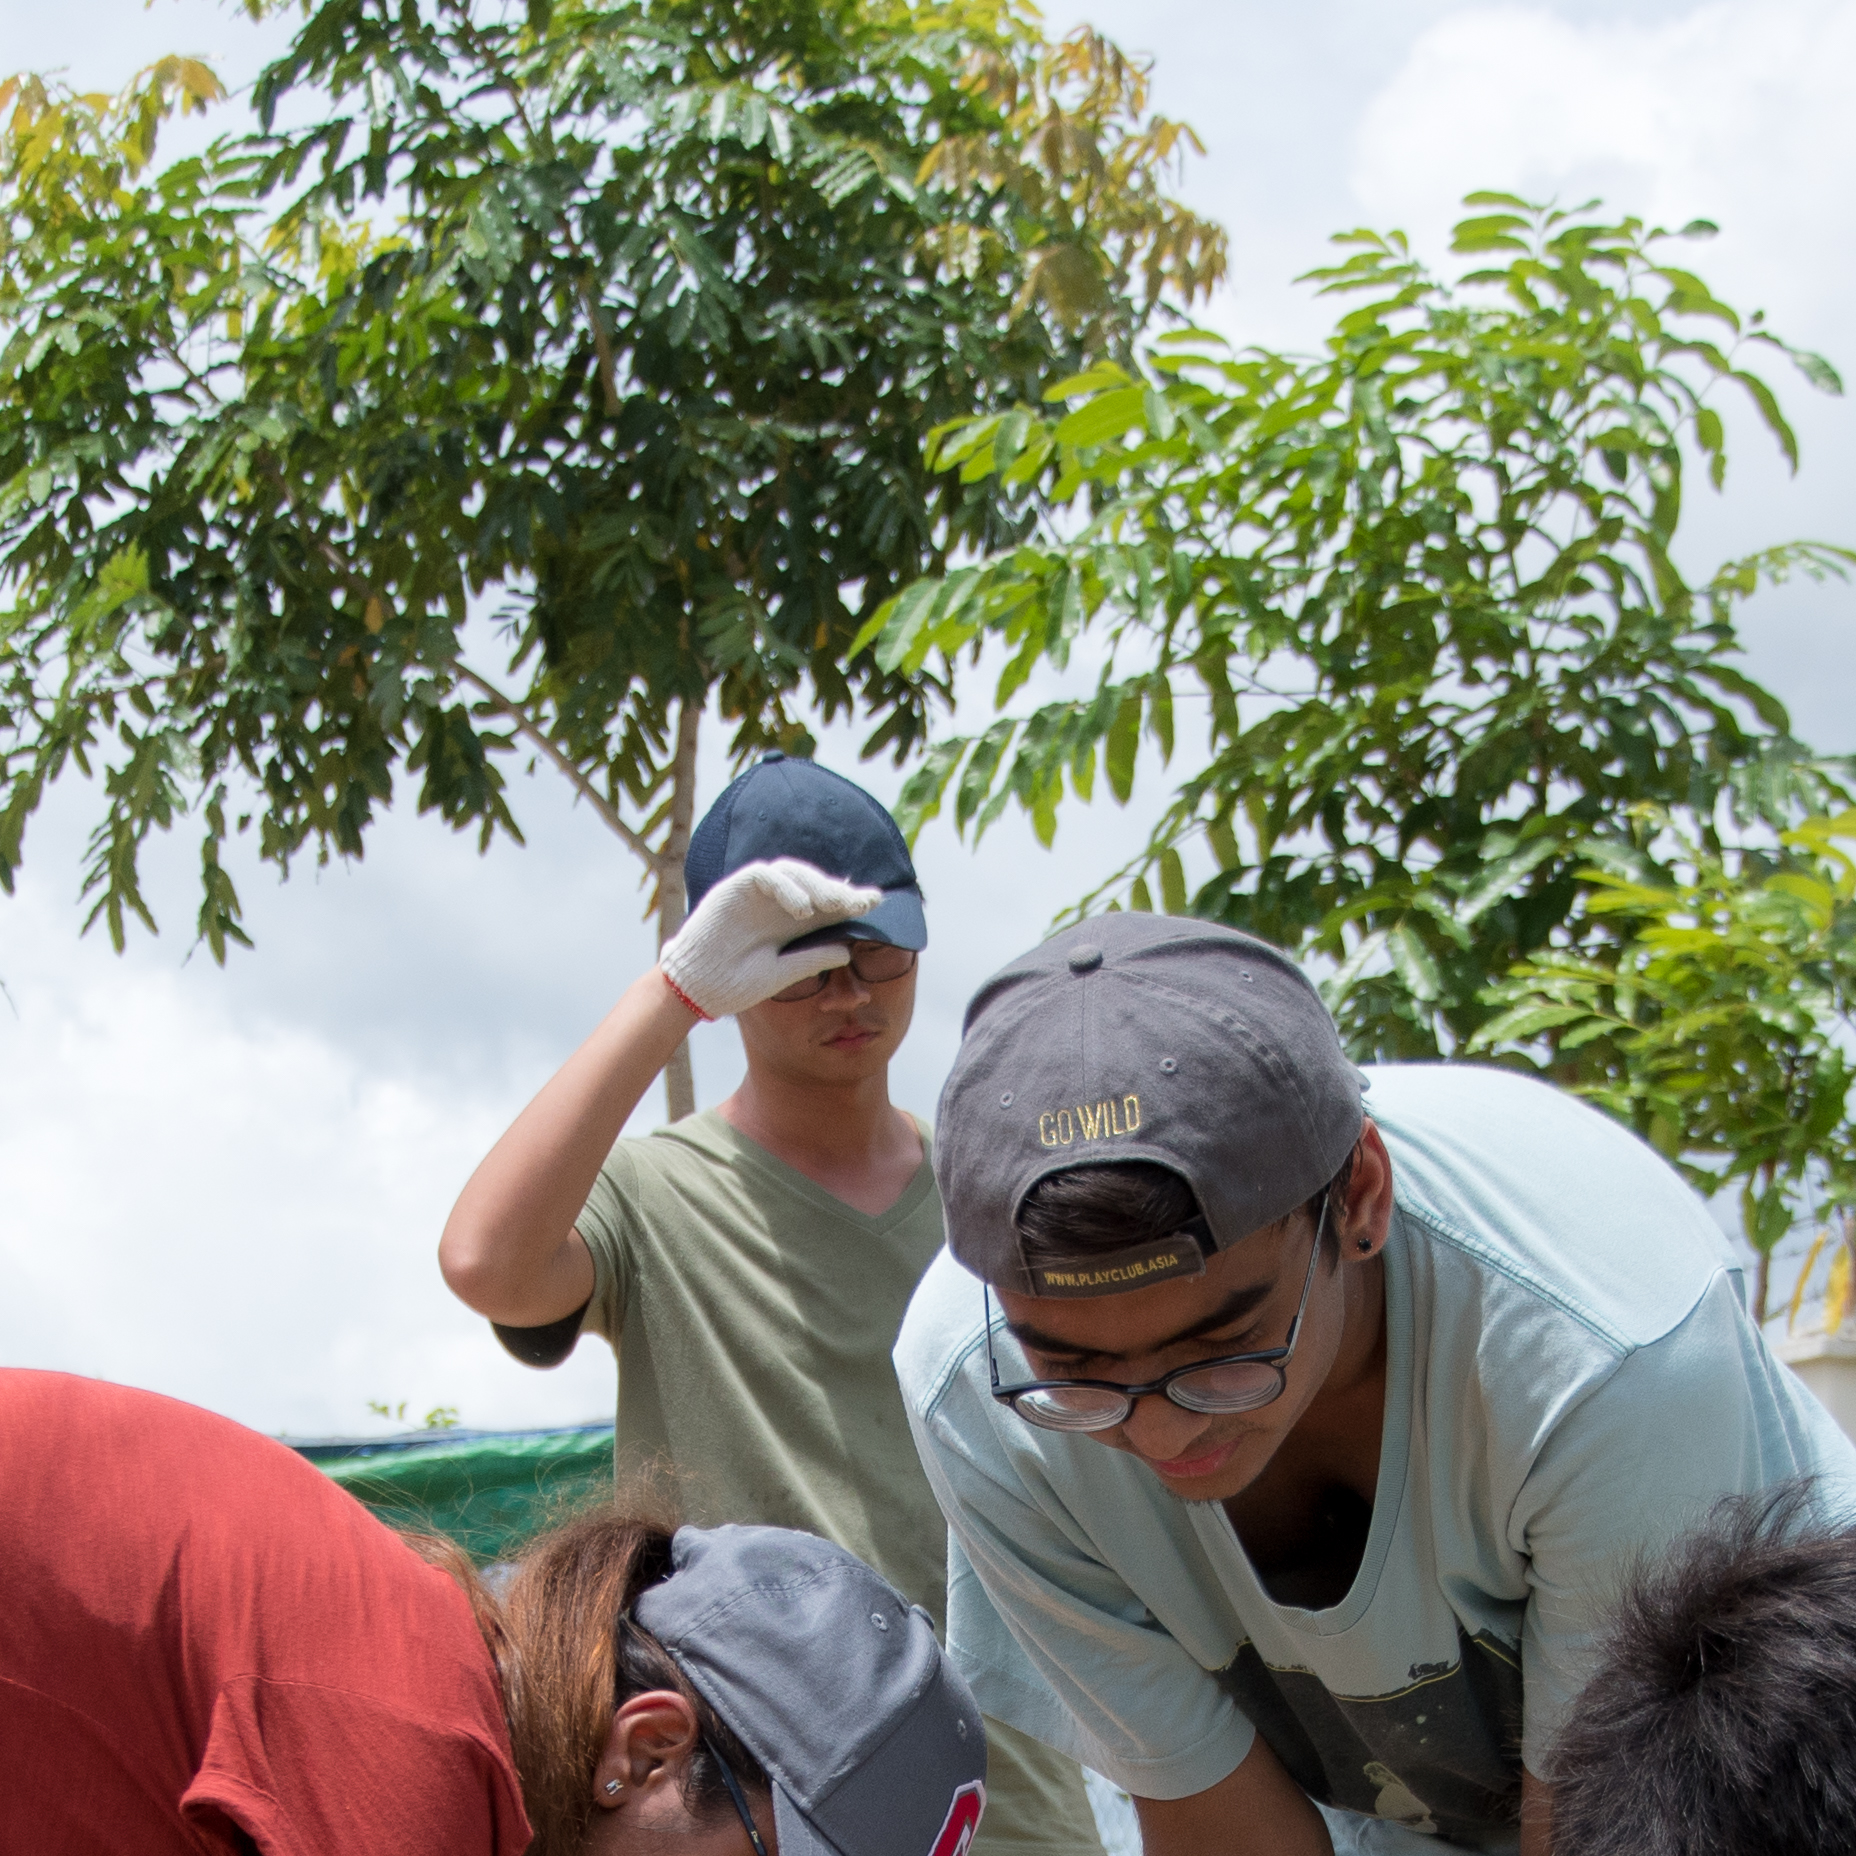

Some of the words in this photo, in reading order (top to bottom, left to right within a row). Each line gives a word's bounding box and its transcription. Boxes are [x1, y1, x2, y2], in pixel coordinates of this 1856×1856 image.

[1039, 1109, 1074, 1146] GO
[1076, 1095, 1140, 1141] WILD
[1044, 1253, 1178, 1287] WWW.PLAYCLUB.ASIA
